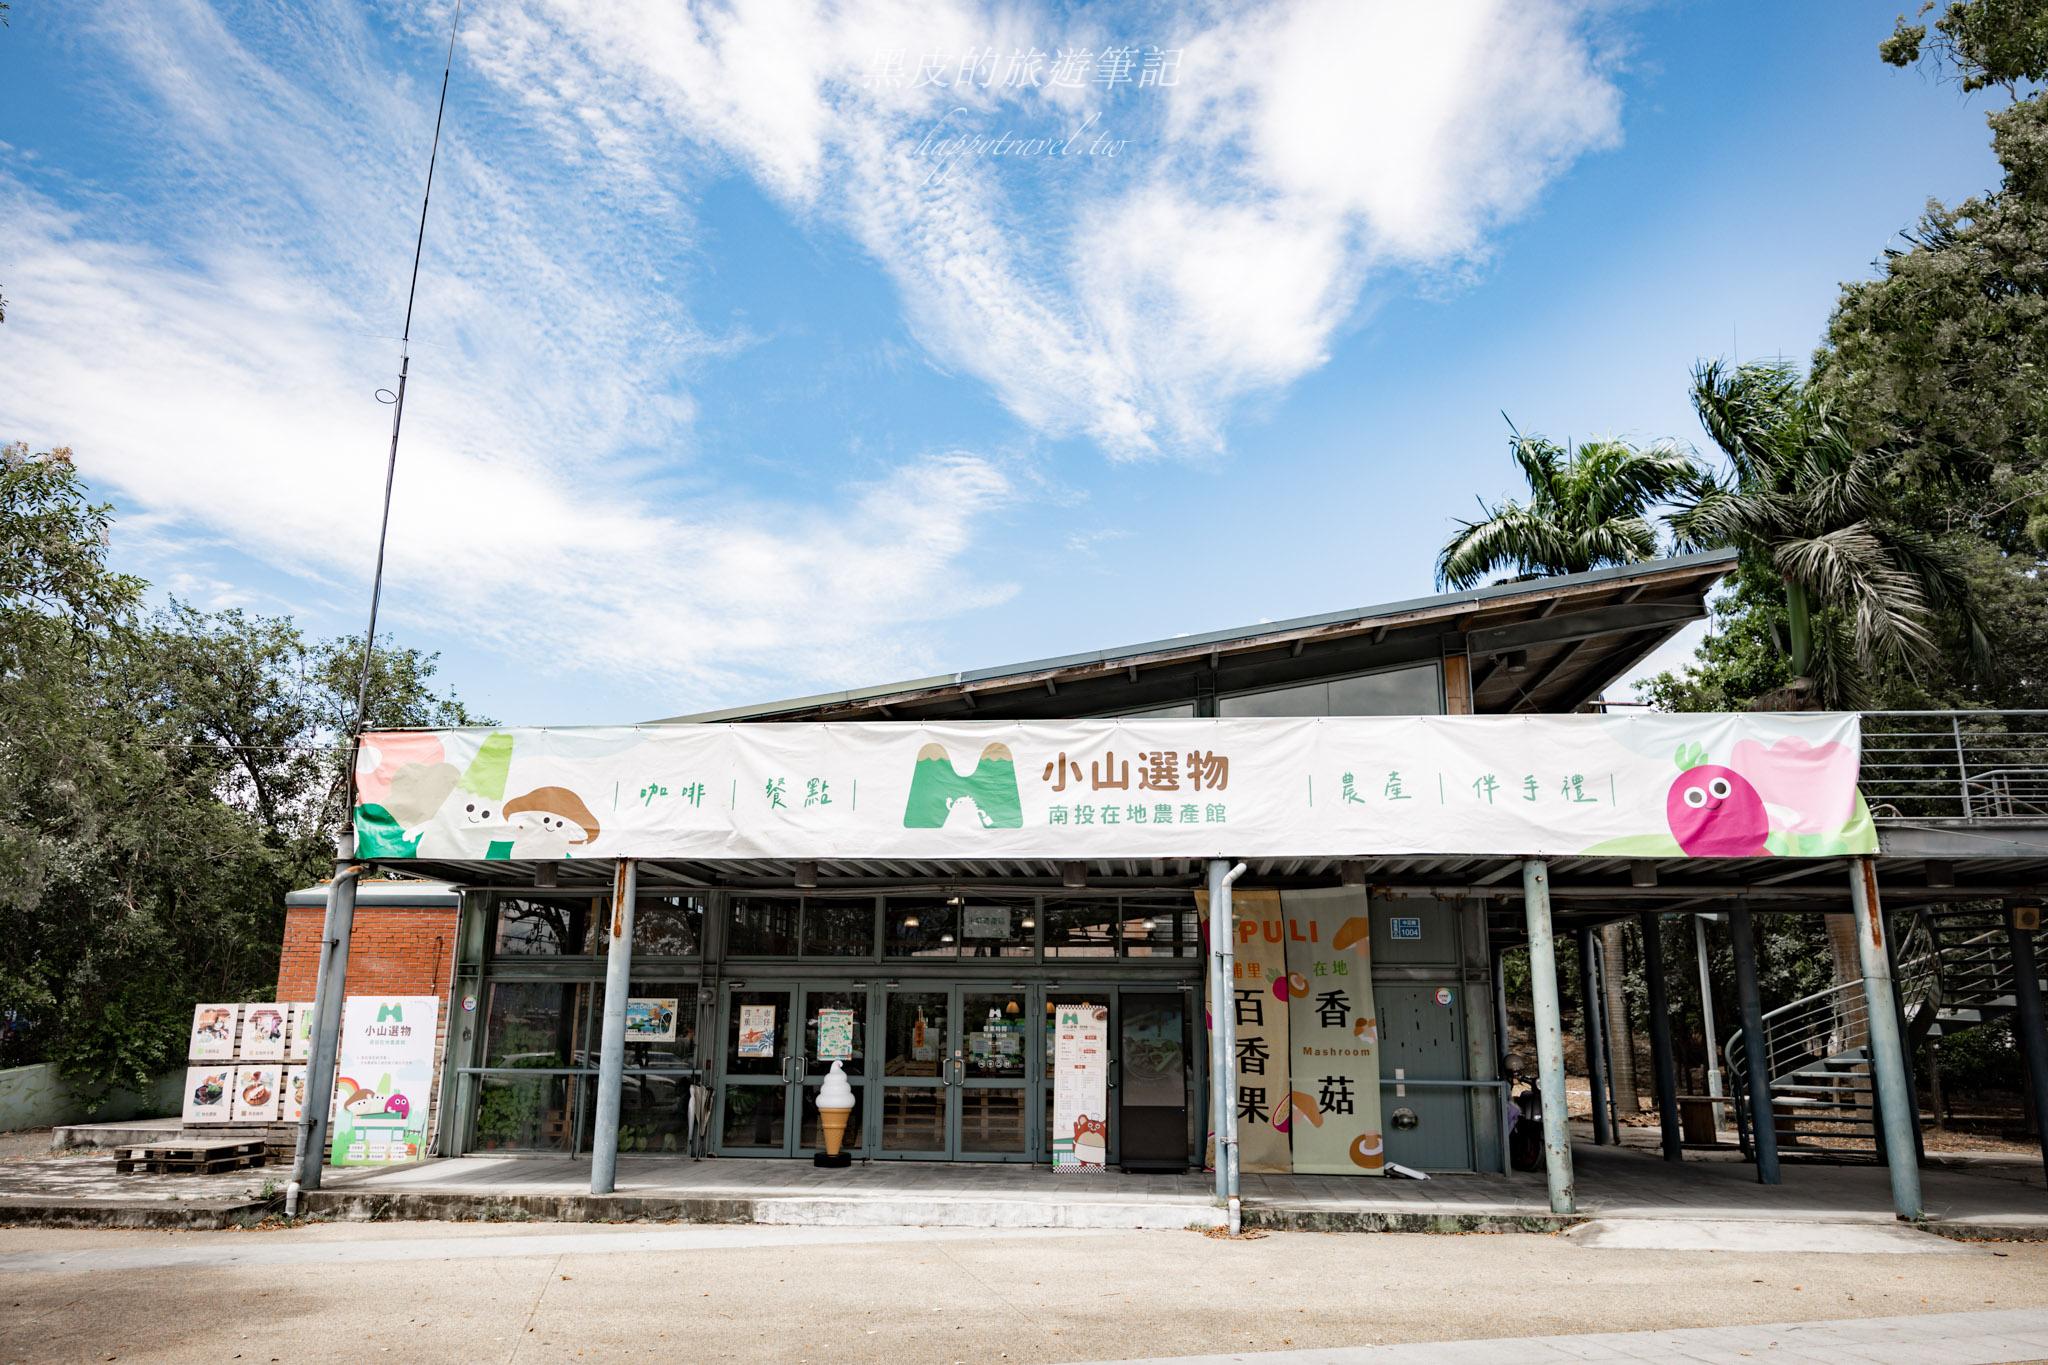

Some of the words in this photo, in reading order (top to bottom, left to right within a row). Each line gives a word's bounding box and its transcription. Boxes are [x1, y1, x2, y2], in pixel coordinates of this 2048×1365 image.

[1042, 750, 1230, 792] 小山選物
[639, 782, 706, 808] 咖啡
[765, 777, 833, 809] 餐點
[1342, 770, 1412, 804] 農產
[1472, 773, 1598, 804] 伴手禮
[1048, 803, 1226, 825] 南投在地農產館
[1239, 919, 1320, 944] PULI
[1401, 928, 1418, 936] 1004
[1313, 960, 1349, 977] 在地
[365, 1025, 412, 1037] 小山選物
[1234, 989, 1270, 1124] 百香果
[1303, 1046, 1370, 1057] Mashroom
[1315, 989, 1354, 1115] 香菇
